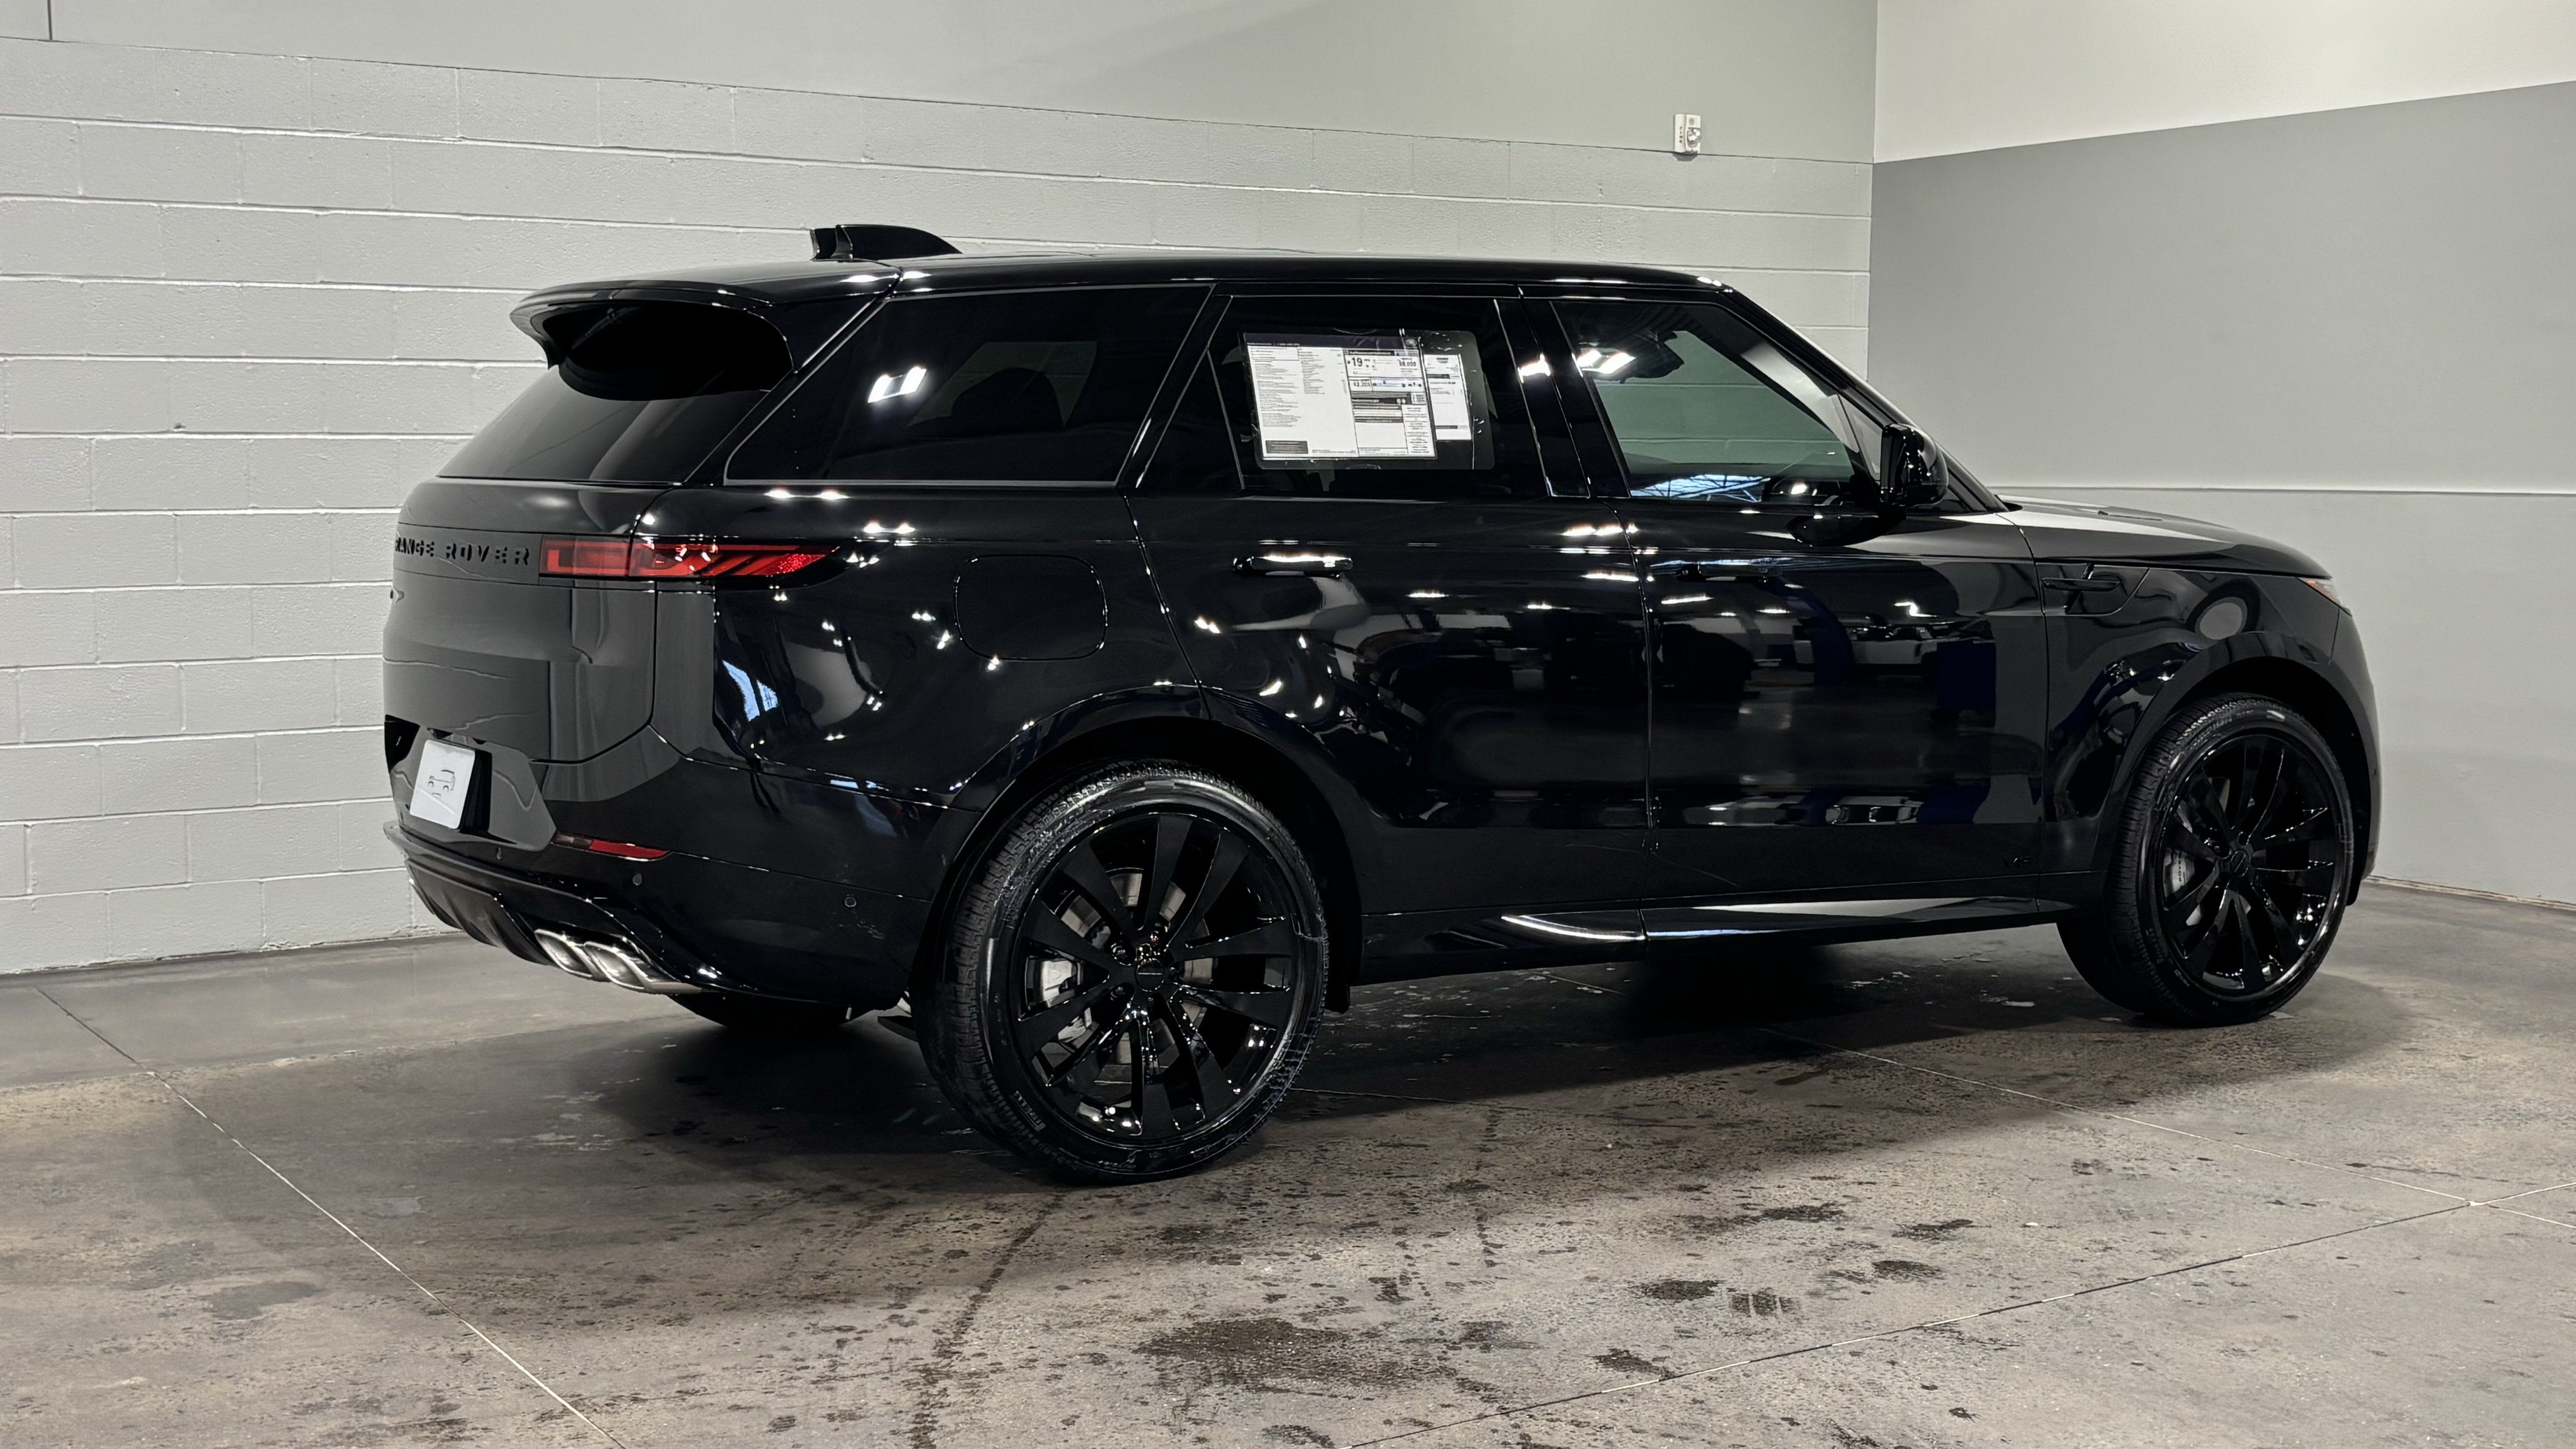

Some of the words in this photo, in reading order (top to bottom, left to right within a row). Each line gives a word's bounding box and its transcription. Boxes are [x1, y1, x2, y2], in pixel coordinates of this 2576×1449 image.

[1352, 357, 1362, 367] 19
[396, 537, 435, 557] RANGE
[446, 543, 529, 566] ROVER
